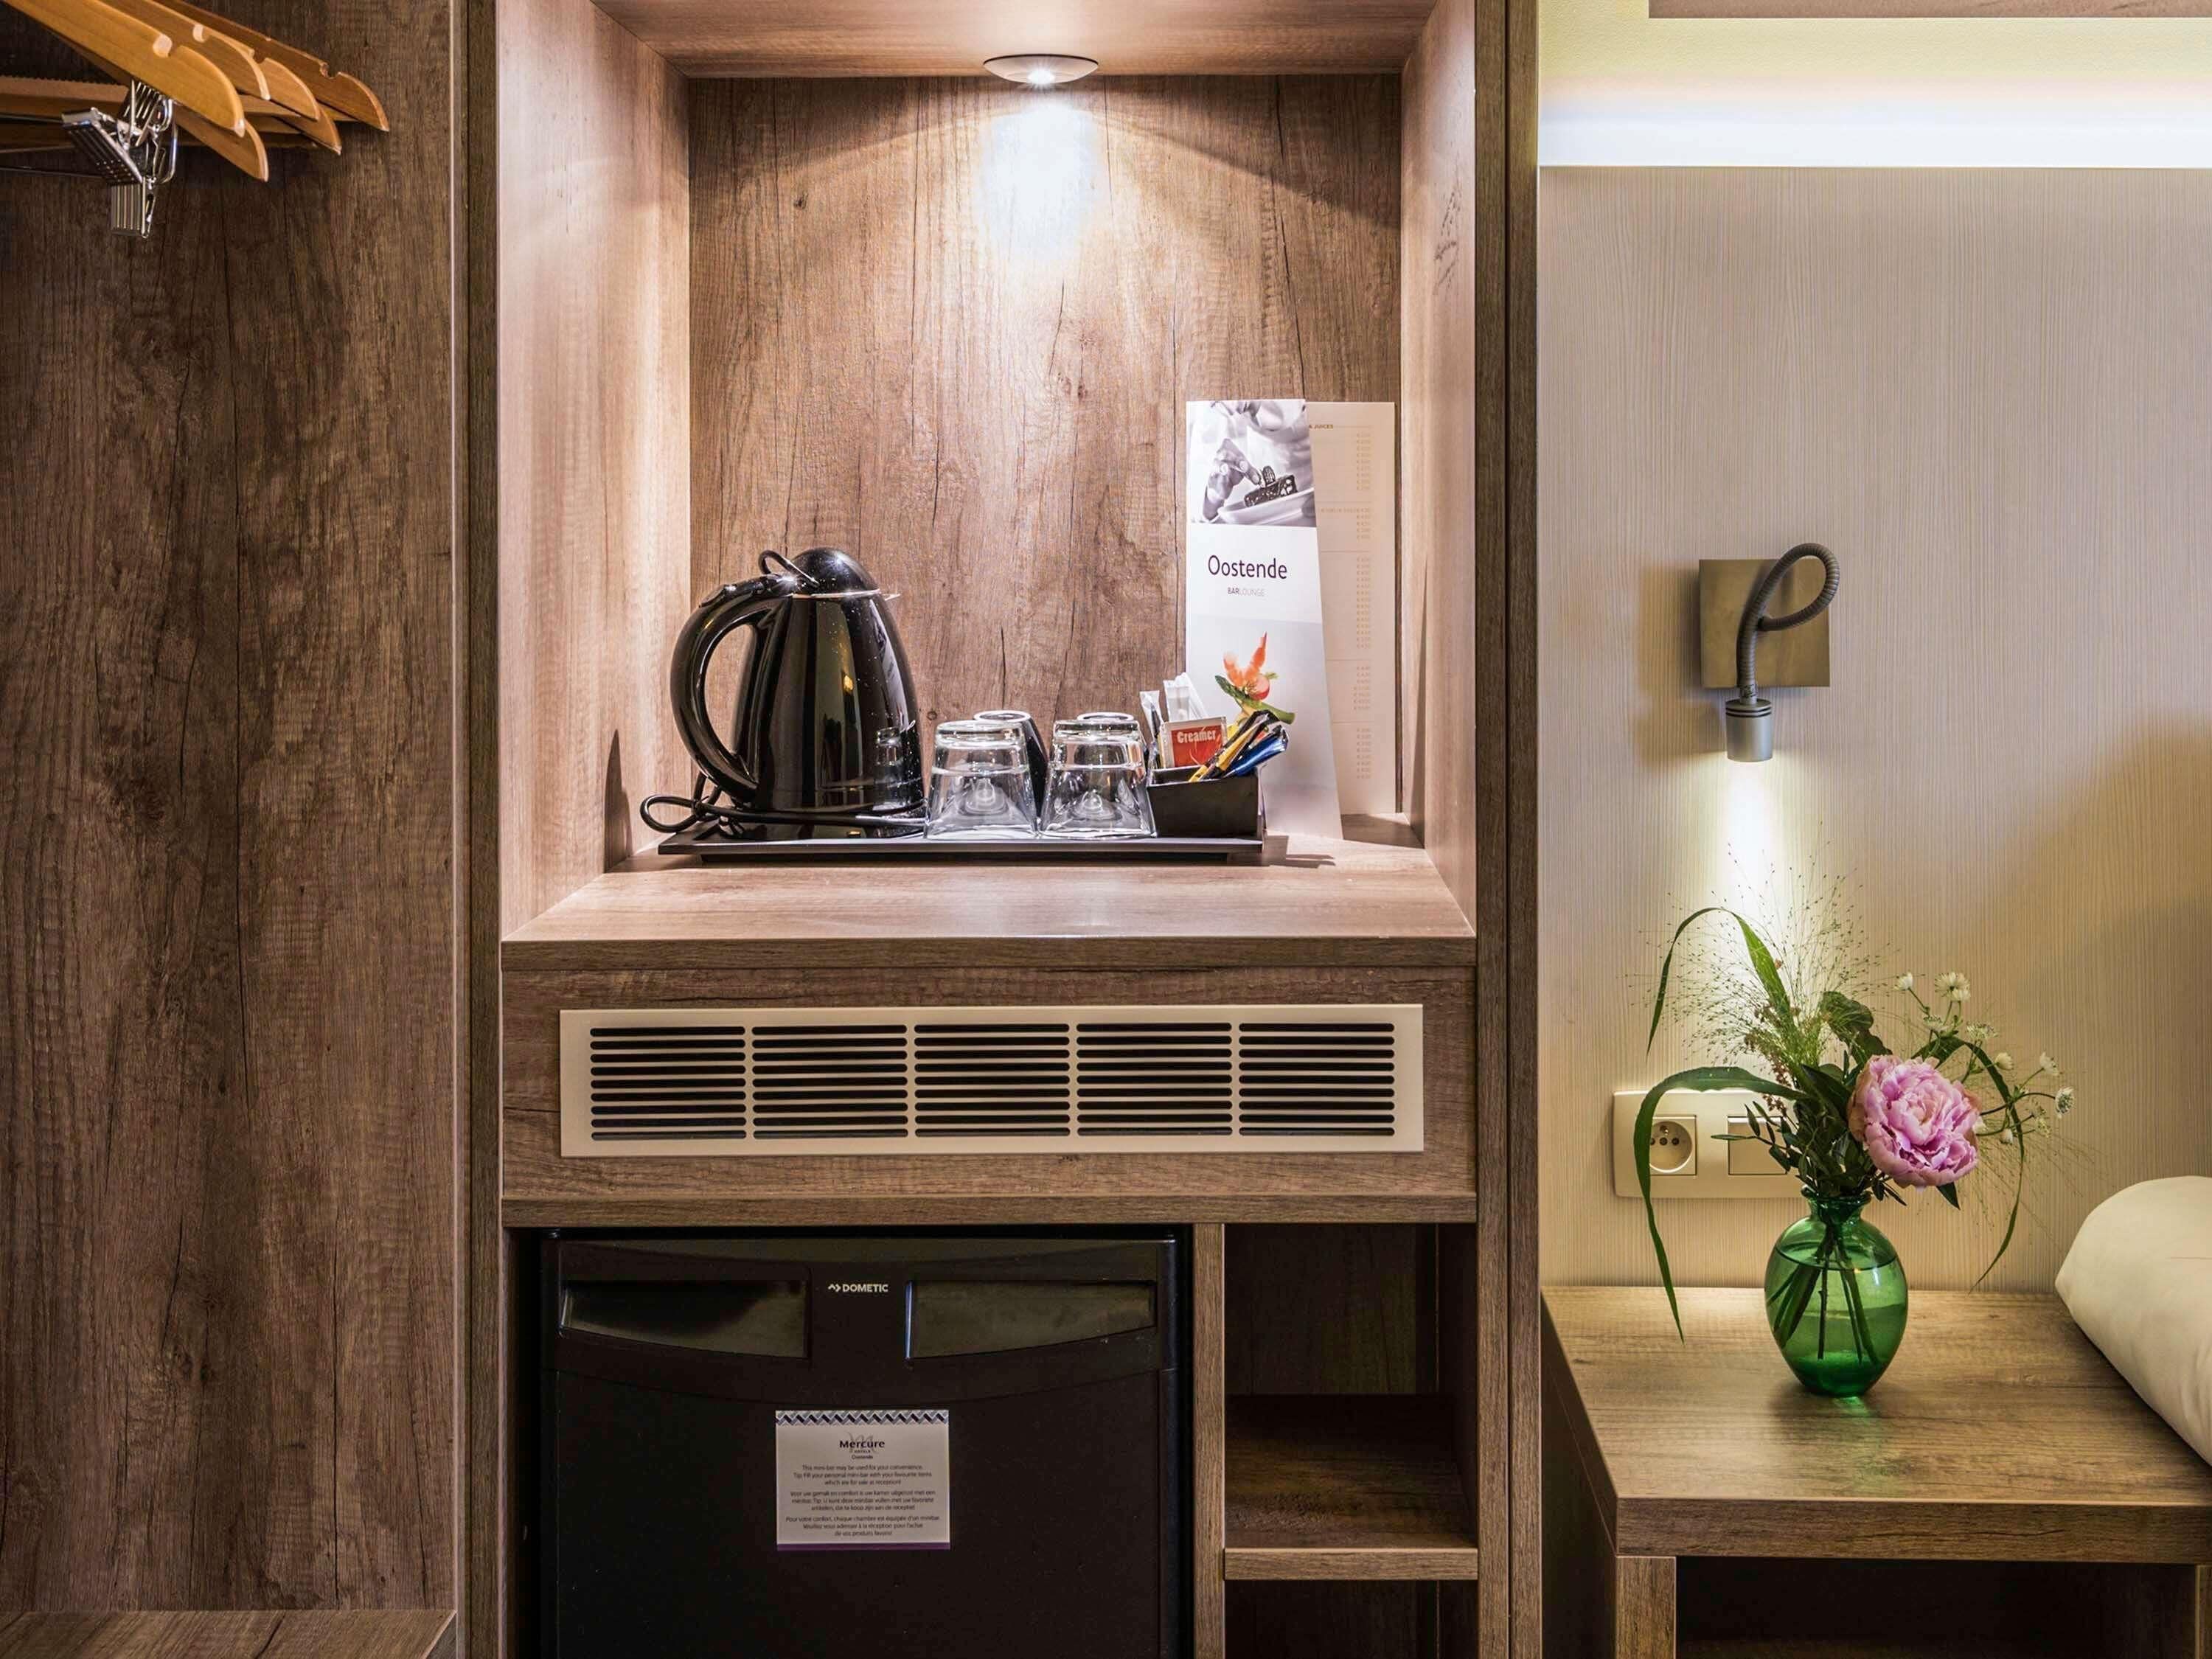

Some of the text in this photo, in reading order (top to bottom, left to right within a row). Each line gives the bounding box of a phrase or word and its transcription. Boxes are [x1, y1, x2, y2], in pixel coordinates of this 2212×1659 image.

[1208, 554, 1287, 580] Oostende
[1177, 729, 1217, 744] Creamer
[842, 1284, 888, 1293] DOMETIC
[839, 1440, 885, 1449] Mercure
